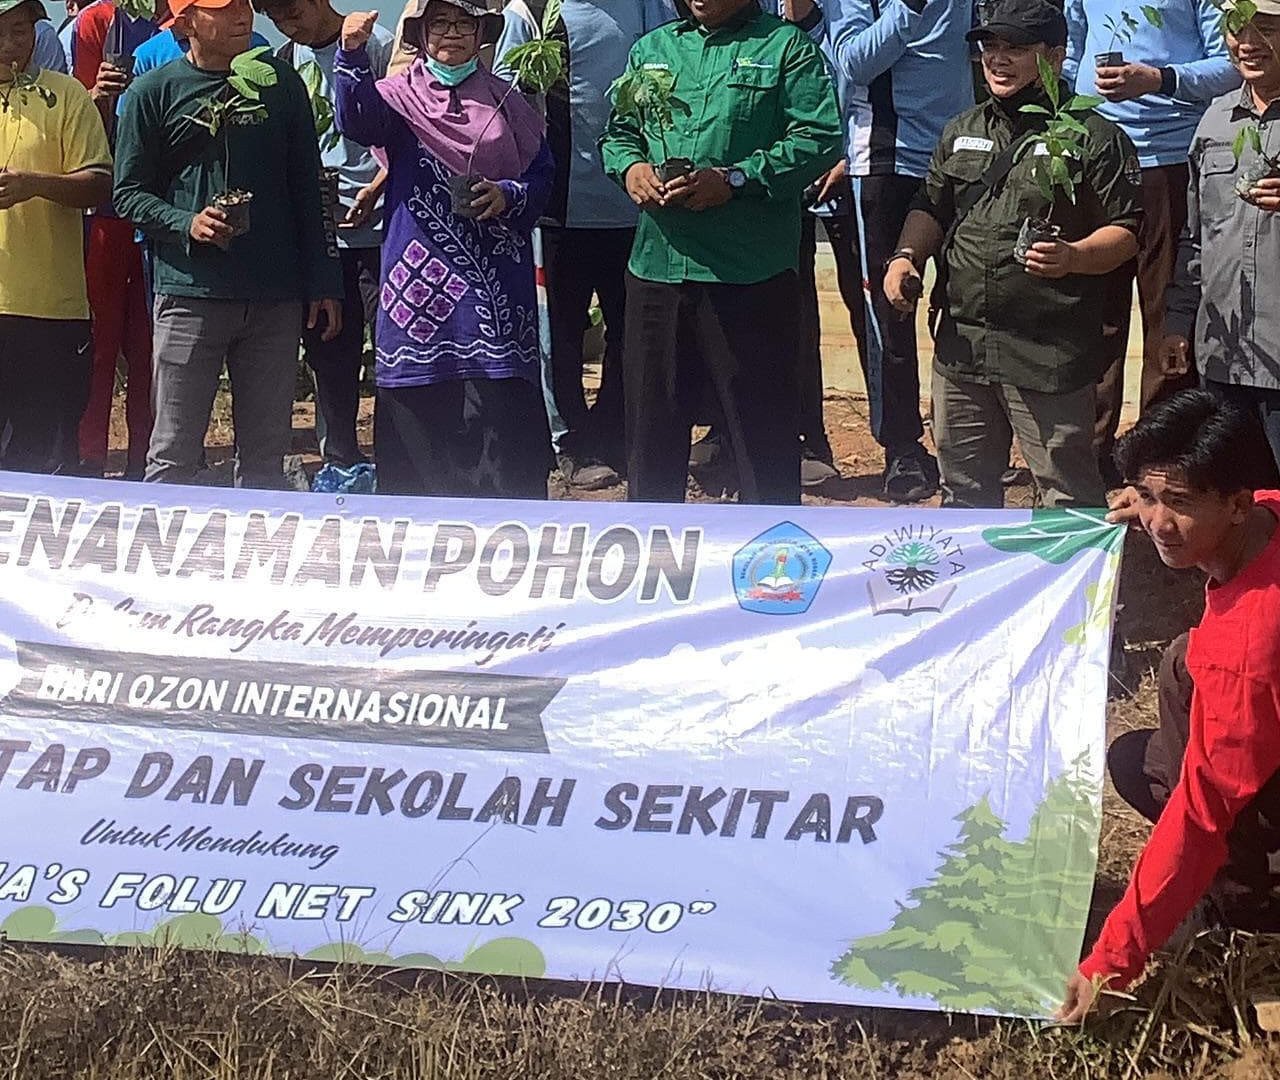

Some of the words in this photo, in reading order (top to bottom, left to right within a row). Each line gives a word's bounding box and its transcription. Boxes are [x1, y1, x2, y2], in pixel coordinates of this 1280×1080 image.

[423, 522, 701, 602] POHON
[861, 524, 966, 576] ADIWIYATA
[173, 603, 301, 653] Rangka
[304, 612, 566, 666] Memperingati
[36, 663, 123, 705] HARI
[128, 672, 230, 713] OZON
[233, 680, 509, 731] INTERNASIONAL
[124, 751, 266, 806] DAN
[277, 764, 577, 827] SEKOLAH
[594, 782, 884, 845] SEKITAR
[80, 818, 172, 847] Untuk
[164, 825, 340, 869] Mendukung
[99, 872, 246, 915] FOLU
[257, 882, 376, 921] NET
[388, 889, 524, 925] SINK
